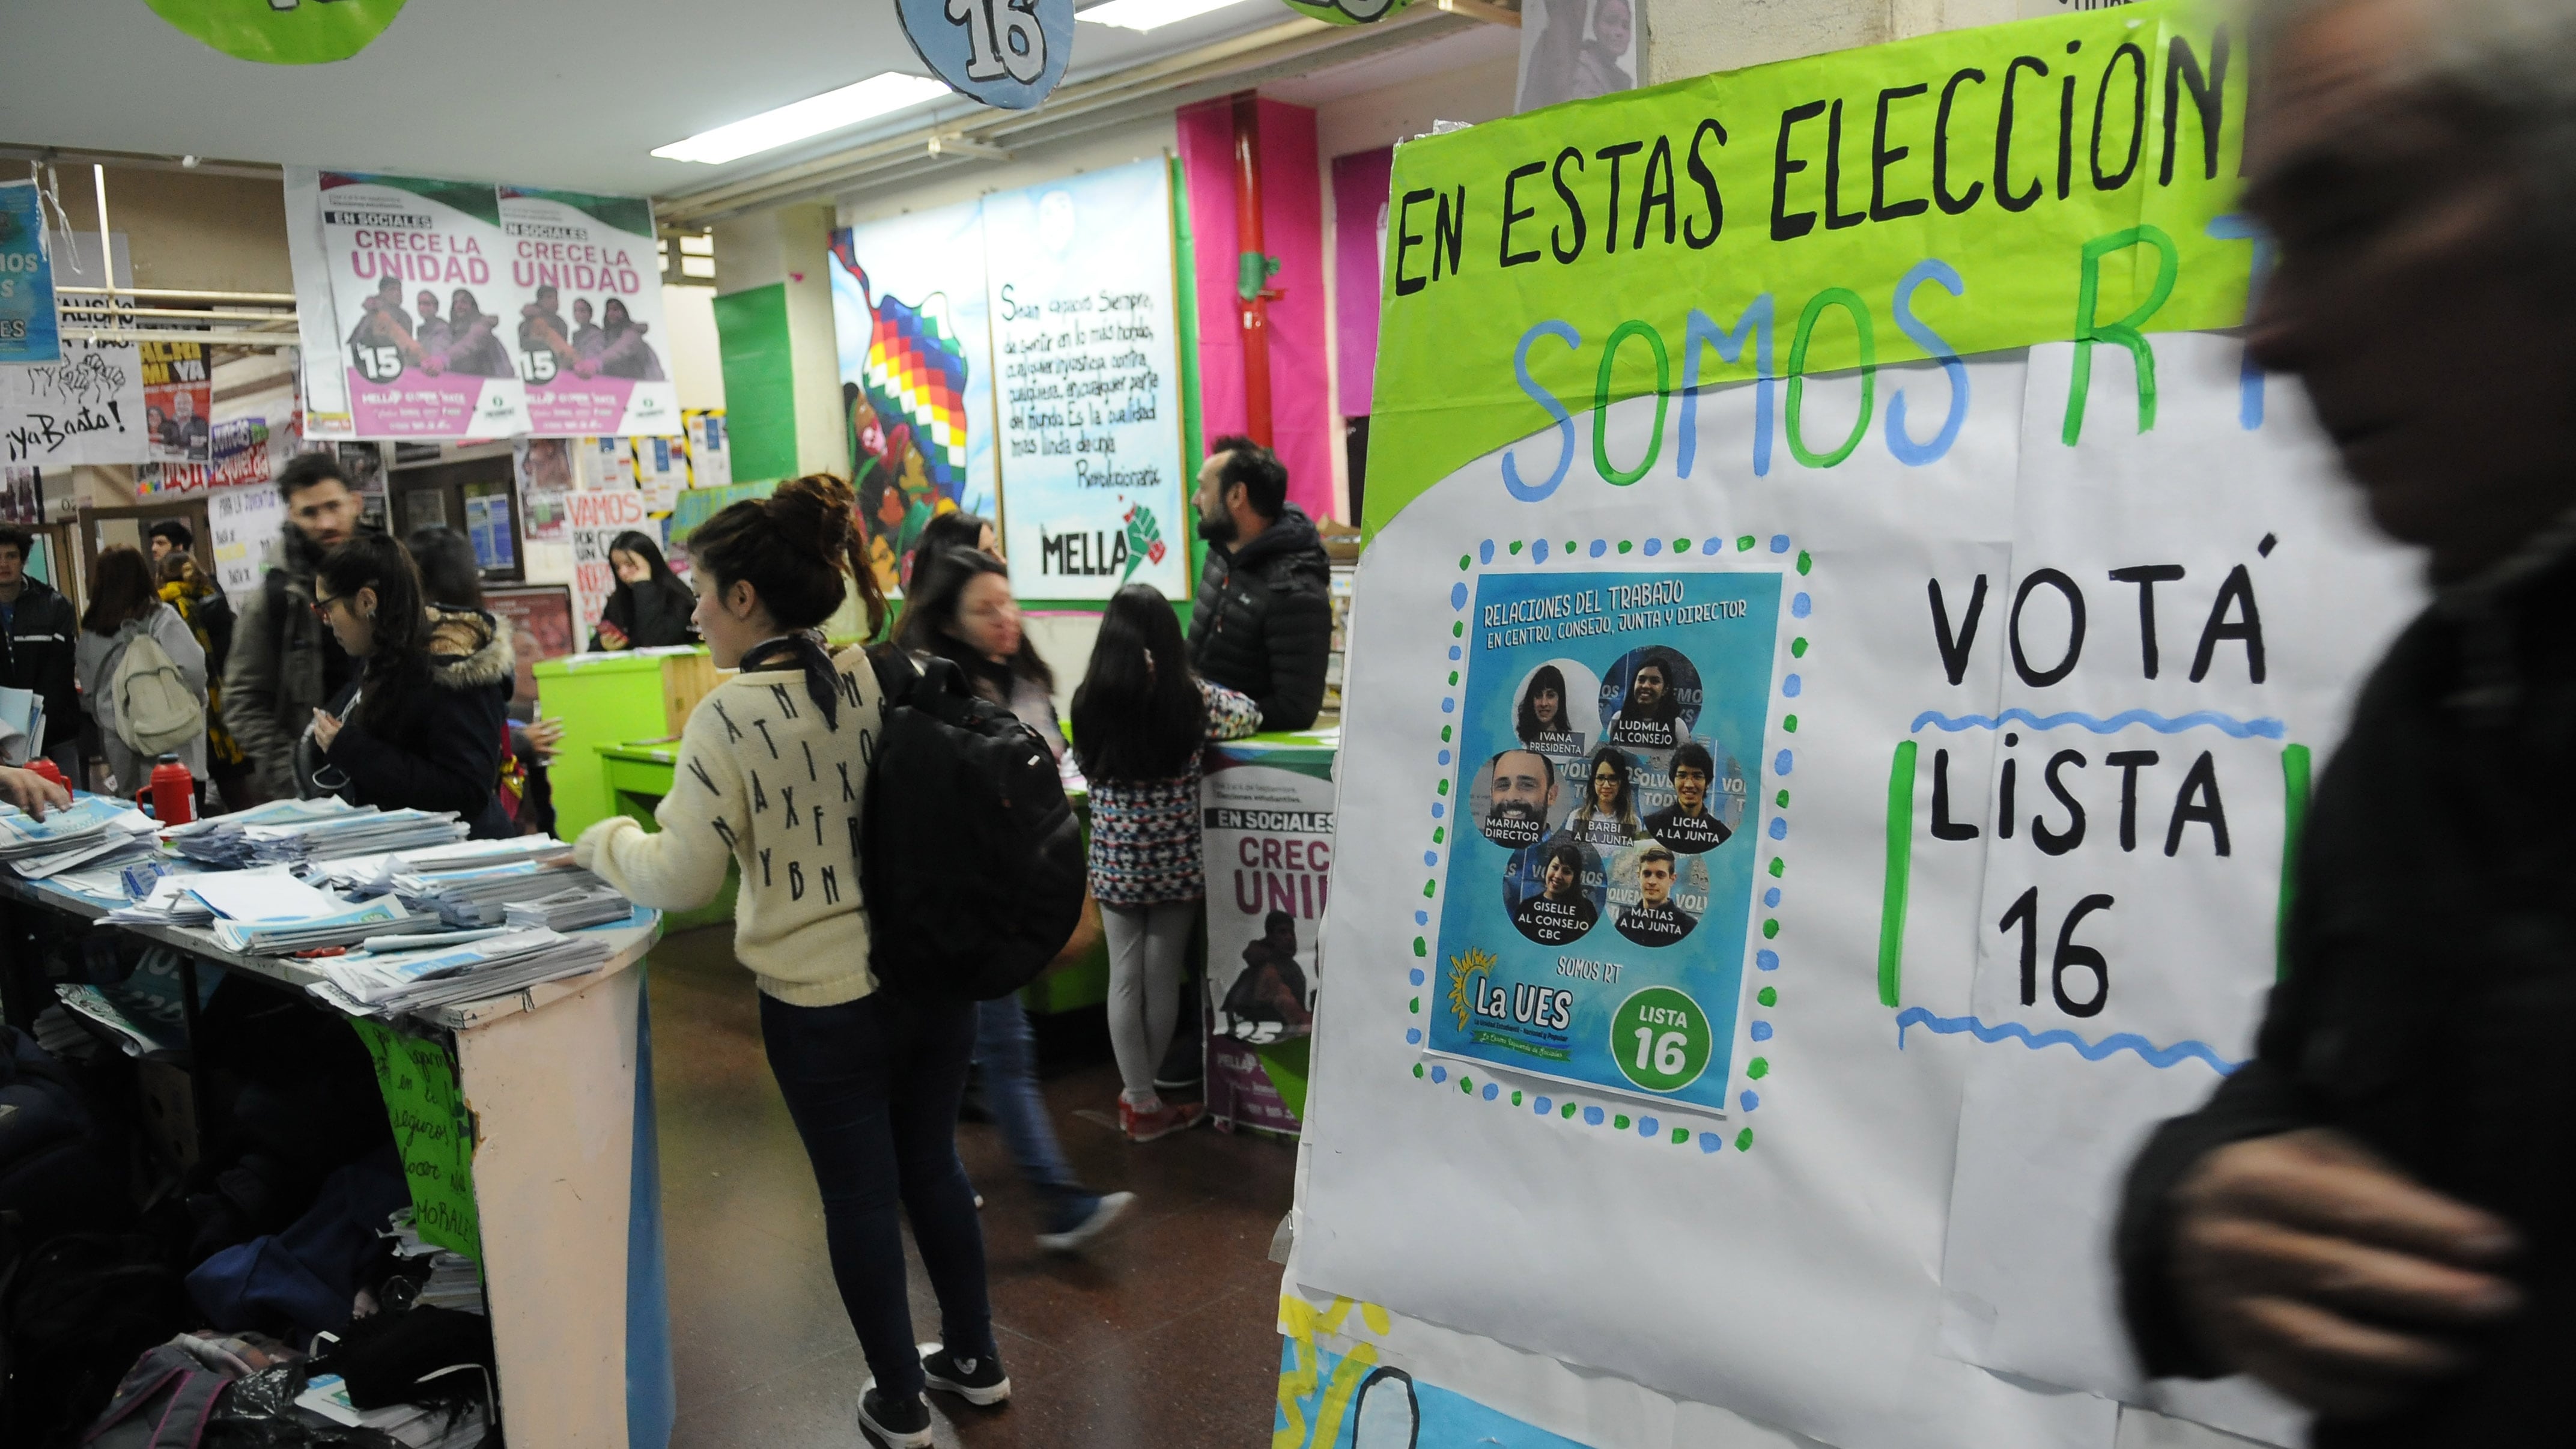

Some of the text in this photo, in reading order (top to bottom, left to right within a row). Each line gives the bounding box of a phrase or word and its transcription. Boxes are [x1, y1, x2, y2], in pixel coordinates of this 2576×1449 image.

[944, 0, 1047, 85] 16
[1396, 183, 1465, 296] EN
[1499, 118, 1728, 267] ESTAS
[354, 229, 480, 254] CRECE LA
[518, 241, 630, 266] CRECE LA
[351, 251, 490, 285] UNIDAD
[512, 260, 640, 294] UNIDAD
[357, 343, 402, 379] 15
[520, 350, 557, 381] 15
[1501, 213, 2276, 503] SOMOS RT
[173, 360, 206, 382] YA
[1068, 400, 1084, 427] Es
[566, 494, 643, 526] VAMOS
[1040, 524, 1128, 575] MELLA
[1483, 578, 1684, 628] RELACIONES DEL TRABAJO
[1928, 532, 2277, 688] VOTÁ
[1486, 598, 1747, 650] EN CENTRO, CONSEJO, JUNTA Y DIRECTOR
[1540, 732, 1573, 743] IVANA
[1612, 732, 1672, 745] AL CONSEJO
[1619, 720, 1670, 733] LUDMILA
[1530, 742, 1582, 755] PRESIDENTA
[1218, 810, 1334, 833] EN SOCIALES
[1486, 818, 1539, 831] MARIANO
[1588, 821, 1621, 833] BARBI
[1672, 816, 1709, 830] LICHA
[1485, 828, 1539, 842] DIRECTOR
[1574, 832, 1634, 847] A LA JUNTA
[1656, 828, 1720, 843] A LA JUNTA
[1239, 836, 1330, 872] CREC
[1533, 901, 1576, 916] GISELLE
[1630, 907, 1674, 922] MATIAS
[1517, 913, 1590, 931] AL CONSEJO
[1620, 918, 1682, 935] A LA JUNTA
[1538, 929, 1561, 941] CBC
[1999, 886, 2115, 1018] 16
[1556, 956, 1623, 984] SOMOS RT
[1475, 976, 1573, 1031] La UES
[1639, 1004, 1688, 1029] LISTA
[1634, 1026, 1688, 1075] 16
